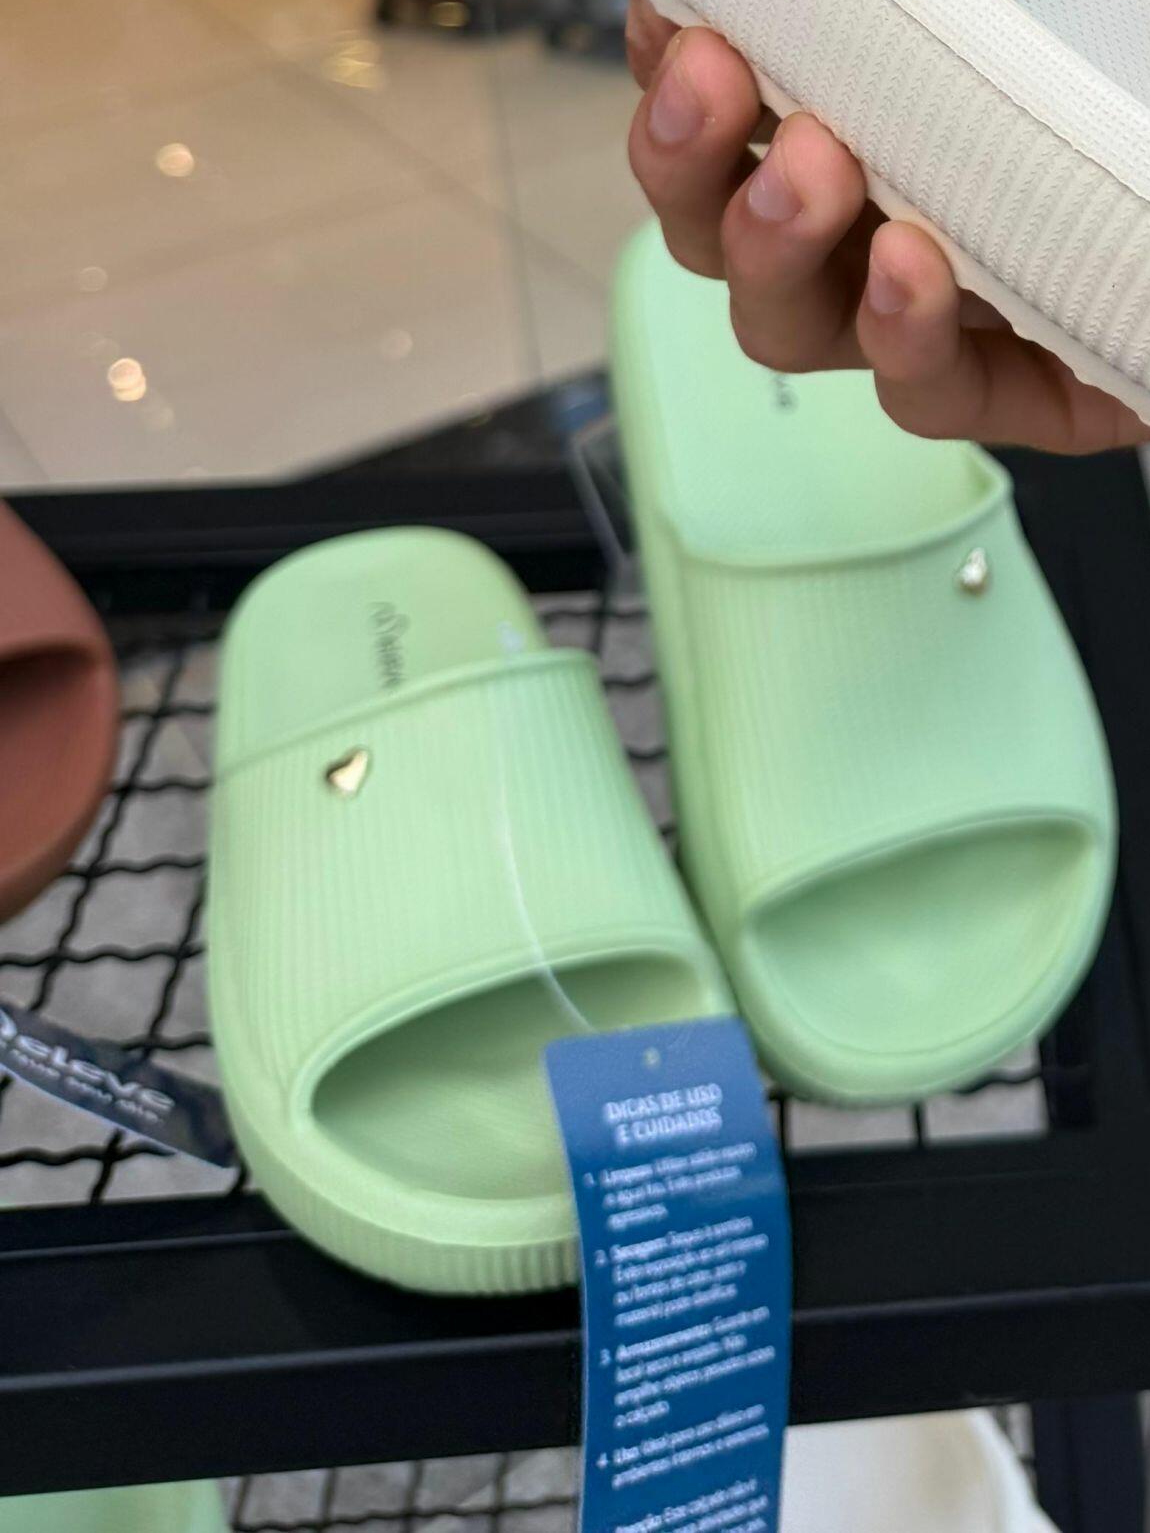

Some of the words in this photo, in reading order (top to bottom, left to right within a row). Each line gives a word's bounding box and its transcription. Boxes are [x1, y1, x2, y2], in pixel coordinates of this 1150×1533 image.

[604, 1096, 659, 1124] DICAS
[659, 1089, 685, 1113] DE
[686, 1083, 722, 1107] USO
[615, 1122, 631, 1148] E
[632, 1107, 722, 1139] CUIDADOS
